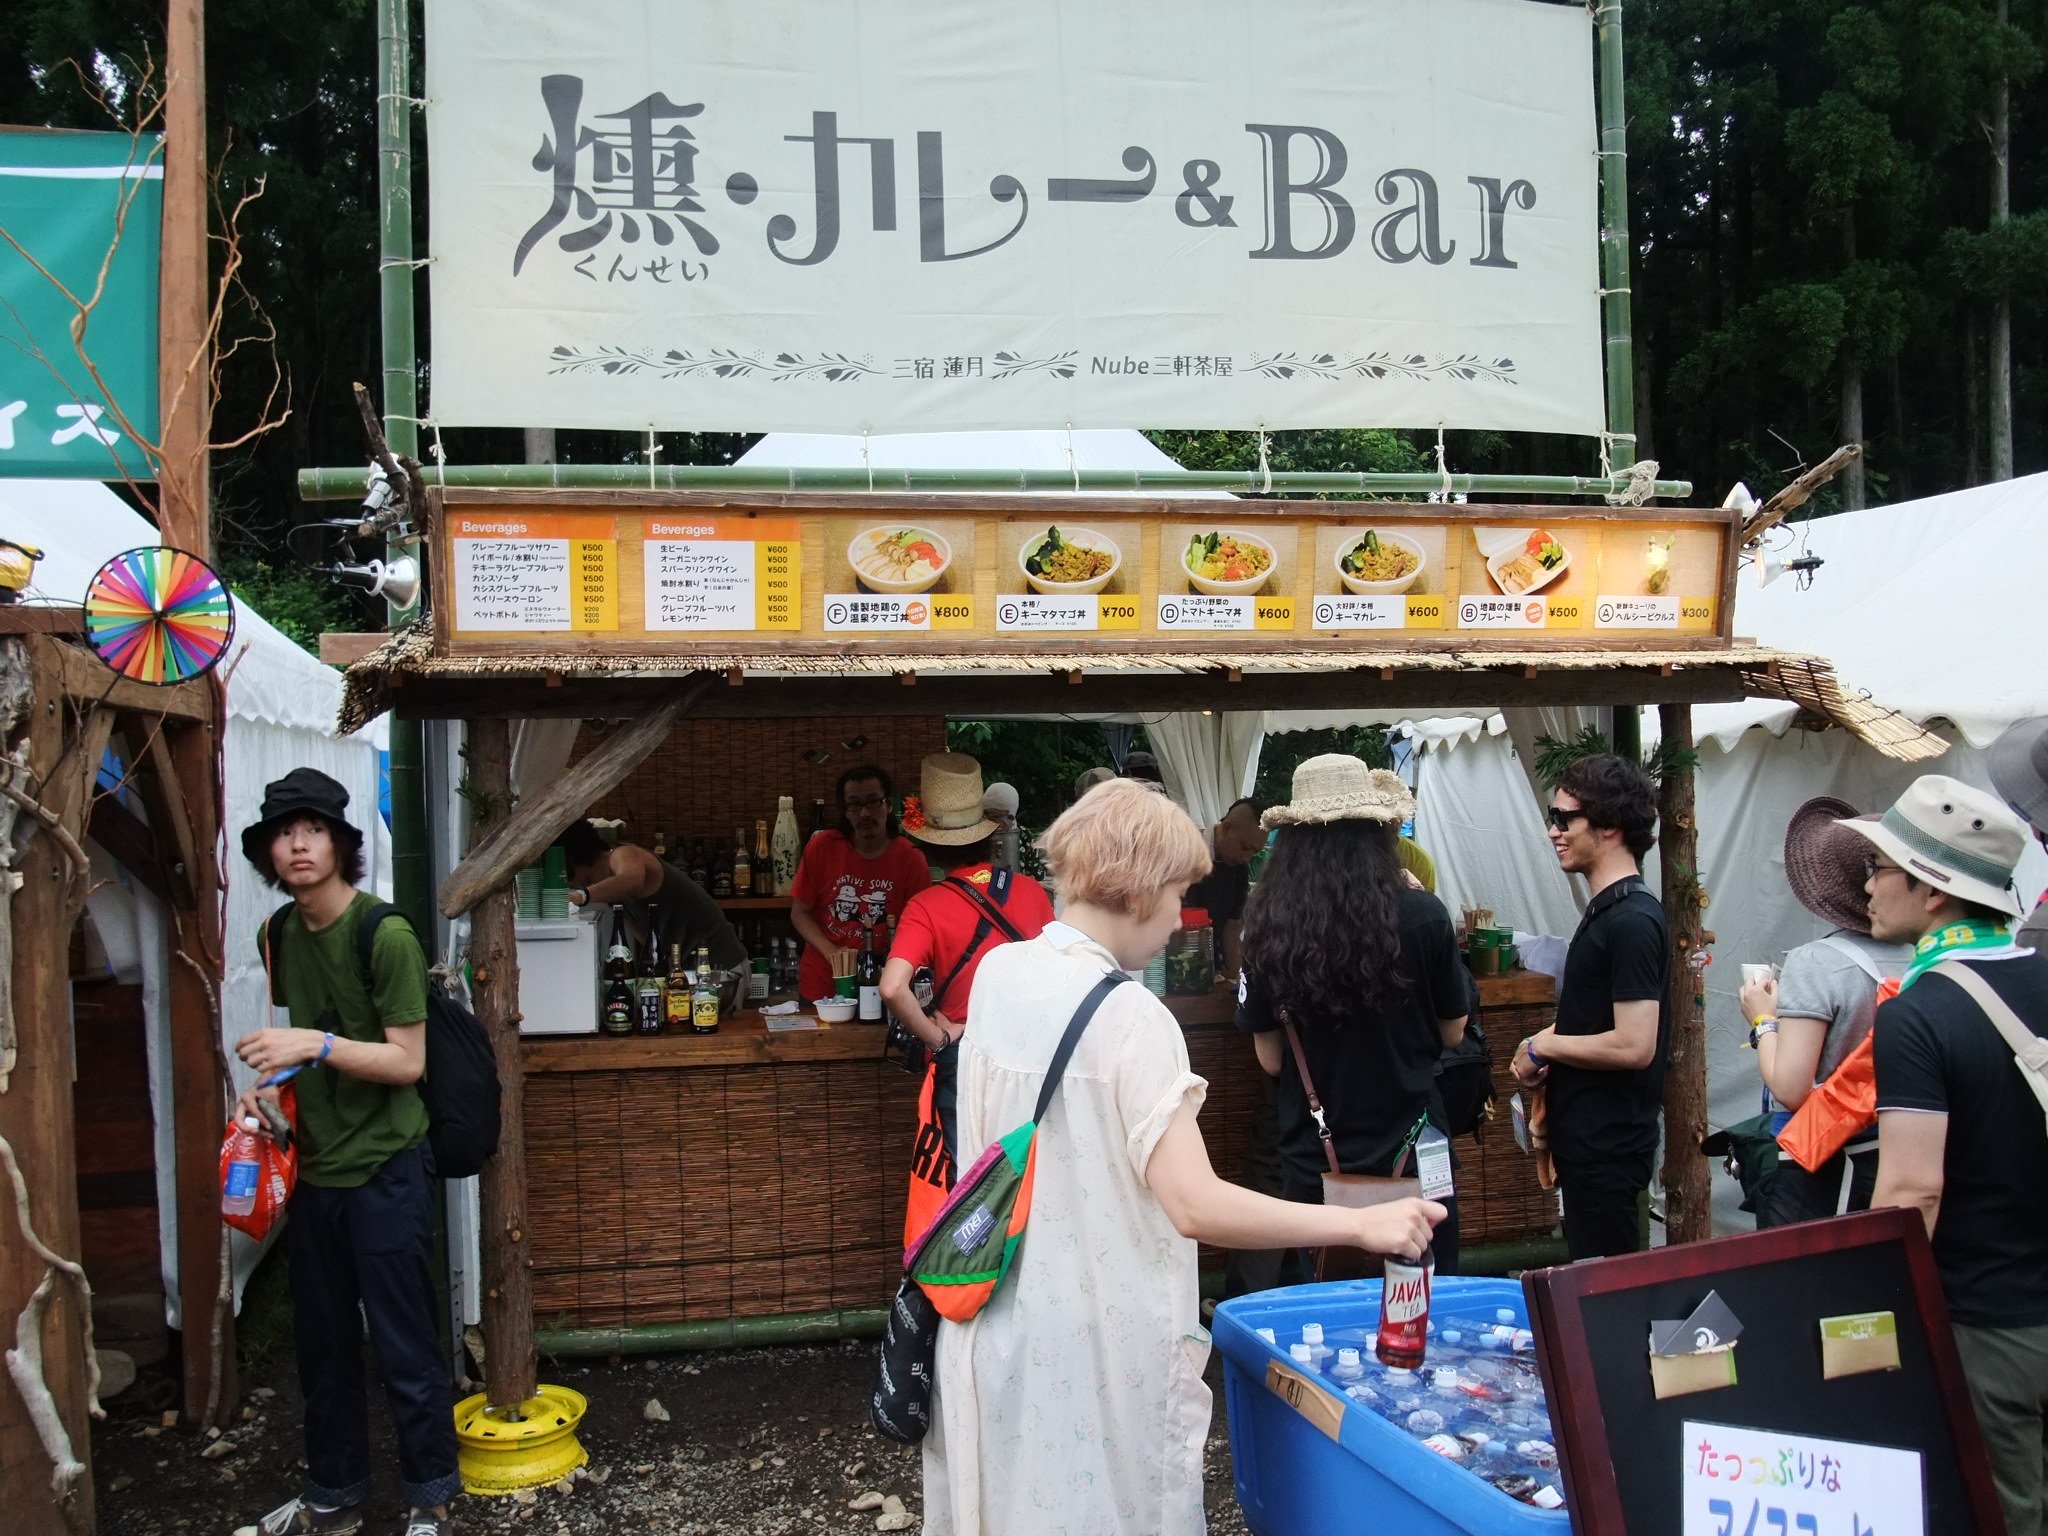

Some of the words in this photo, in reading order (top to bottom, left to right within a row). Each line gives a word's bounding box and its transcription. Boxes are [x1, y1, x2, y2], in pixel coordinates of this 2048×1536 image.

[574, 254, 709, 283] くんせい
[461, 521, 528, 535] Beverages
[652, 523, 715, 537] Beverages
[582, 543, 603, 552] ¥500
[660, 545, 691, 553] 生ビール
[767, 546, 788, 554] ¥600
[582, 554, 604, 562] ¥500
[661, 555, 729, 564] オーガニックワイン
[767, 556, 788, 564] ¥500
[583, 564, 604, 572] ¥500
[661, 565, 738, 574] スパークリングワイン
[767, 566, 788, 574] ¥500
[472, 574, 520, 583] カシスソーダ
[583, 574, 604, 582] ¥500
[767, 580, 788, 588] ¥500
[583, 585, 604, 593] ¥500
[583, 595, 605, 603] ¥500
[661, 595, 706, 603] ウーロンハイ
[767, 594, 788, 602] ¥500
[1181, 598, 1230, 606] たっぷり野菜の
[767, 604, 788, 613] ¥500
[1021, 609, 1086, 620] キーマタマゴ丼
[1102, 606, 1135, 618] ¥700
[1181, 607, 1242, 617] トマトキーマ丼
[1258, 608, 1290, 619] ¥600
[1682, 607, 1709, 618] ¥300
[850, 613, 909, 624] 温泉タマゴ丼
[934, 606, 969, 618] ¥800
[1335, 612, 1386, 622] キーマカレー
[1409, 606, 1439, 617] ¥600
[1480, 613, 1511, 622] プレート
[1549, 607, 1578, 618] ¥500
[662, 615, 707, 623] レモンサワー
[836, 874, 865, 887] NATIVE
[869, 879, 894, 891] SONS
[1388, 1277, 1422, 1305] JAVA
[1402, 1302, 1421, 1318] TEA
